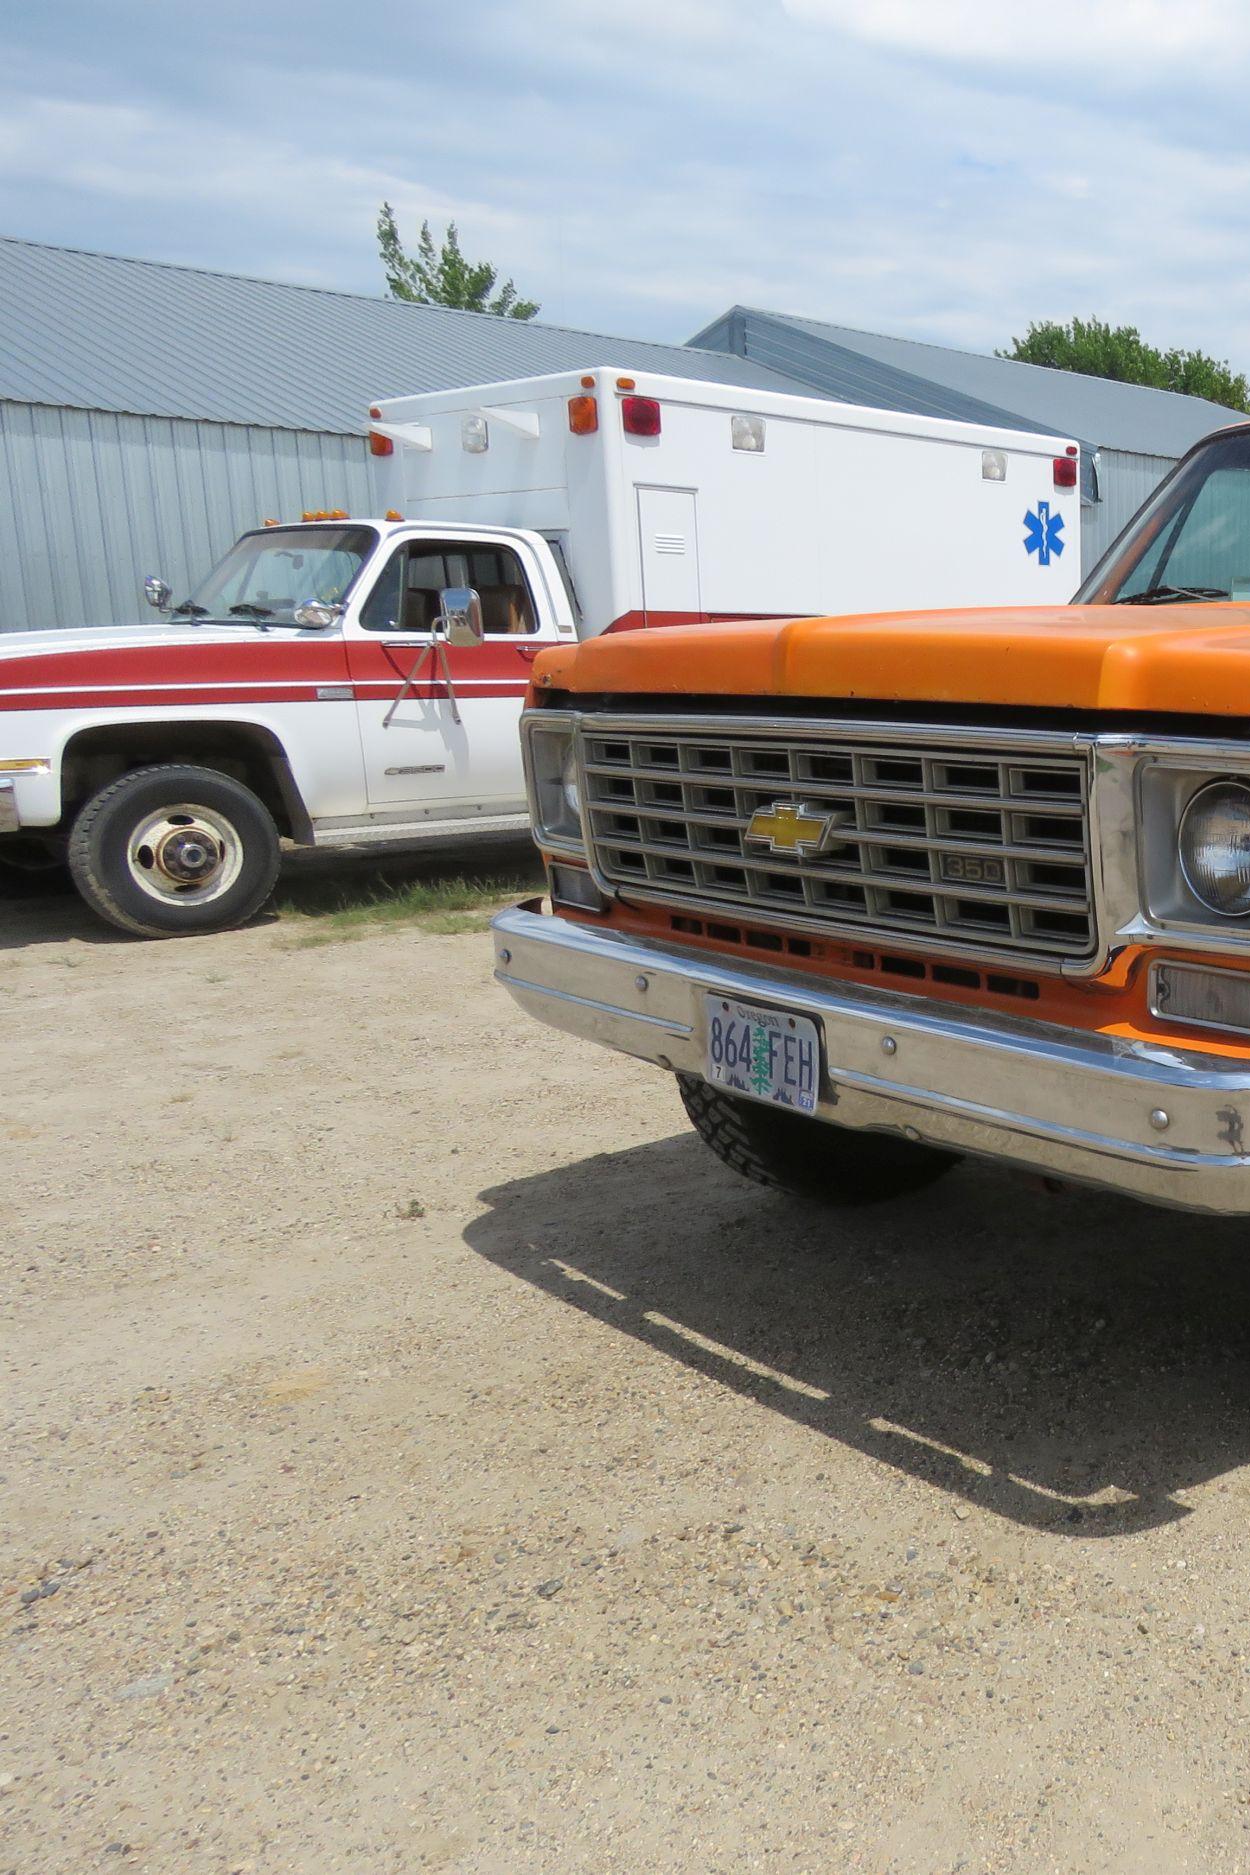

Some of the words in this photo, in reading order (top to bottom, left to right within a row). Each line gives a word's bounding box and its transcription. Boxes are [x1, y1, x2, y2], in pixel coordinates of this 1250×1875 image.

[736, 1005, 781, 1028] Oregon
[711, 1016, 752, 1073] 864
[768, 1030, 813, 1091] FEH
